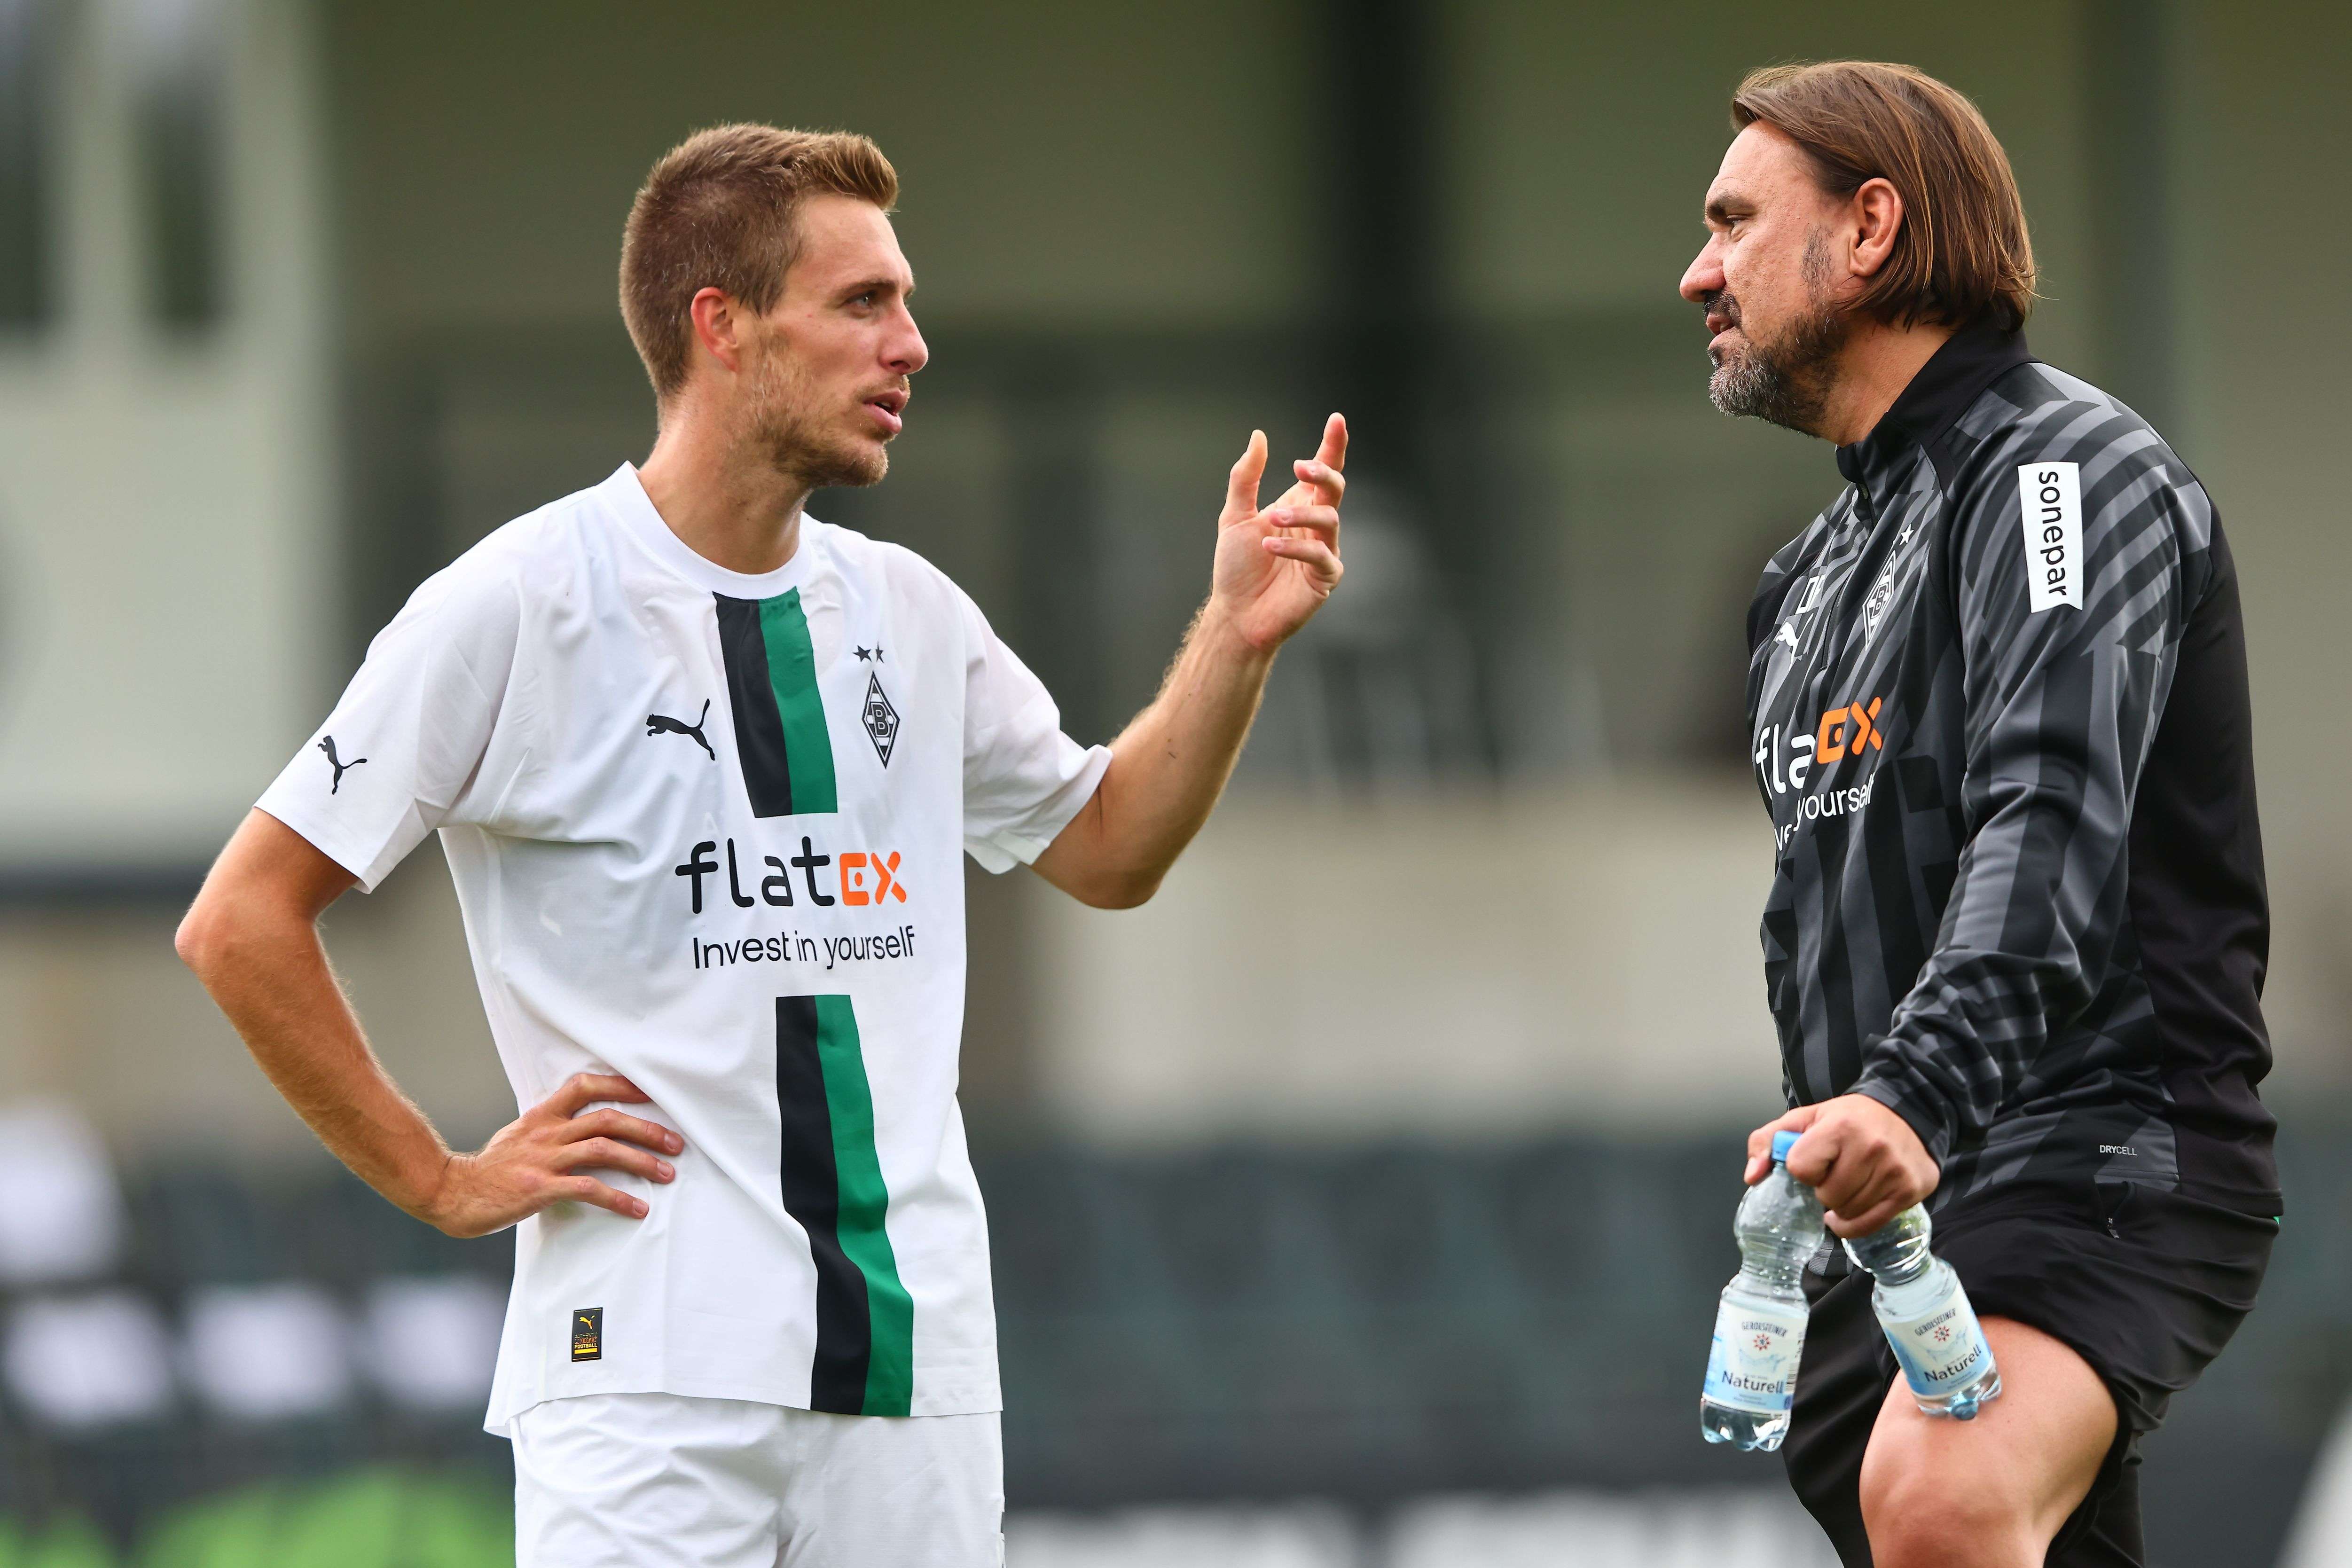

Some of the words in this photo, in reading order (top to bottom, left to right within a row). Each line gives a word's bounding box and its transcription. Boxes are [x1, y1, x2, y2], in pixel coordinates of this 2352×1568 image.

[2038, 471, 2067, 596] sonepar
[869, 702, 890, 737] B
[1756, 697, 1882, 800] flaex
[1793, 771, 1875, 831] yourself
[675, 836, 906, 914] flatex
[693, 932, 791, 969] Invest
[795, 930, 817, 961] in
[823, 925, 915, 970] yourself
[2100, 1145, 2137, 1156] DRYCELL
[1722, 1371, 1784, 1394] Naturell
[1924, 1344, 1982, 1382] Naturell
